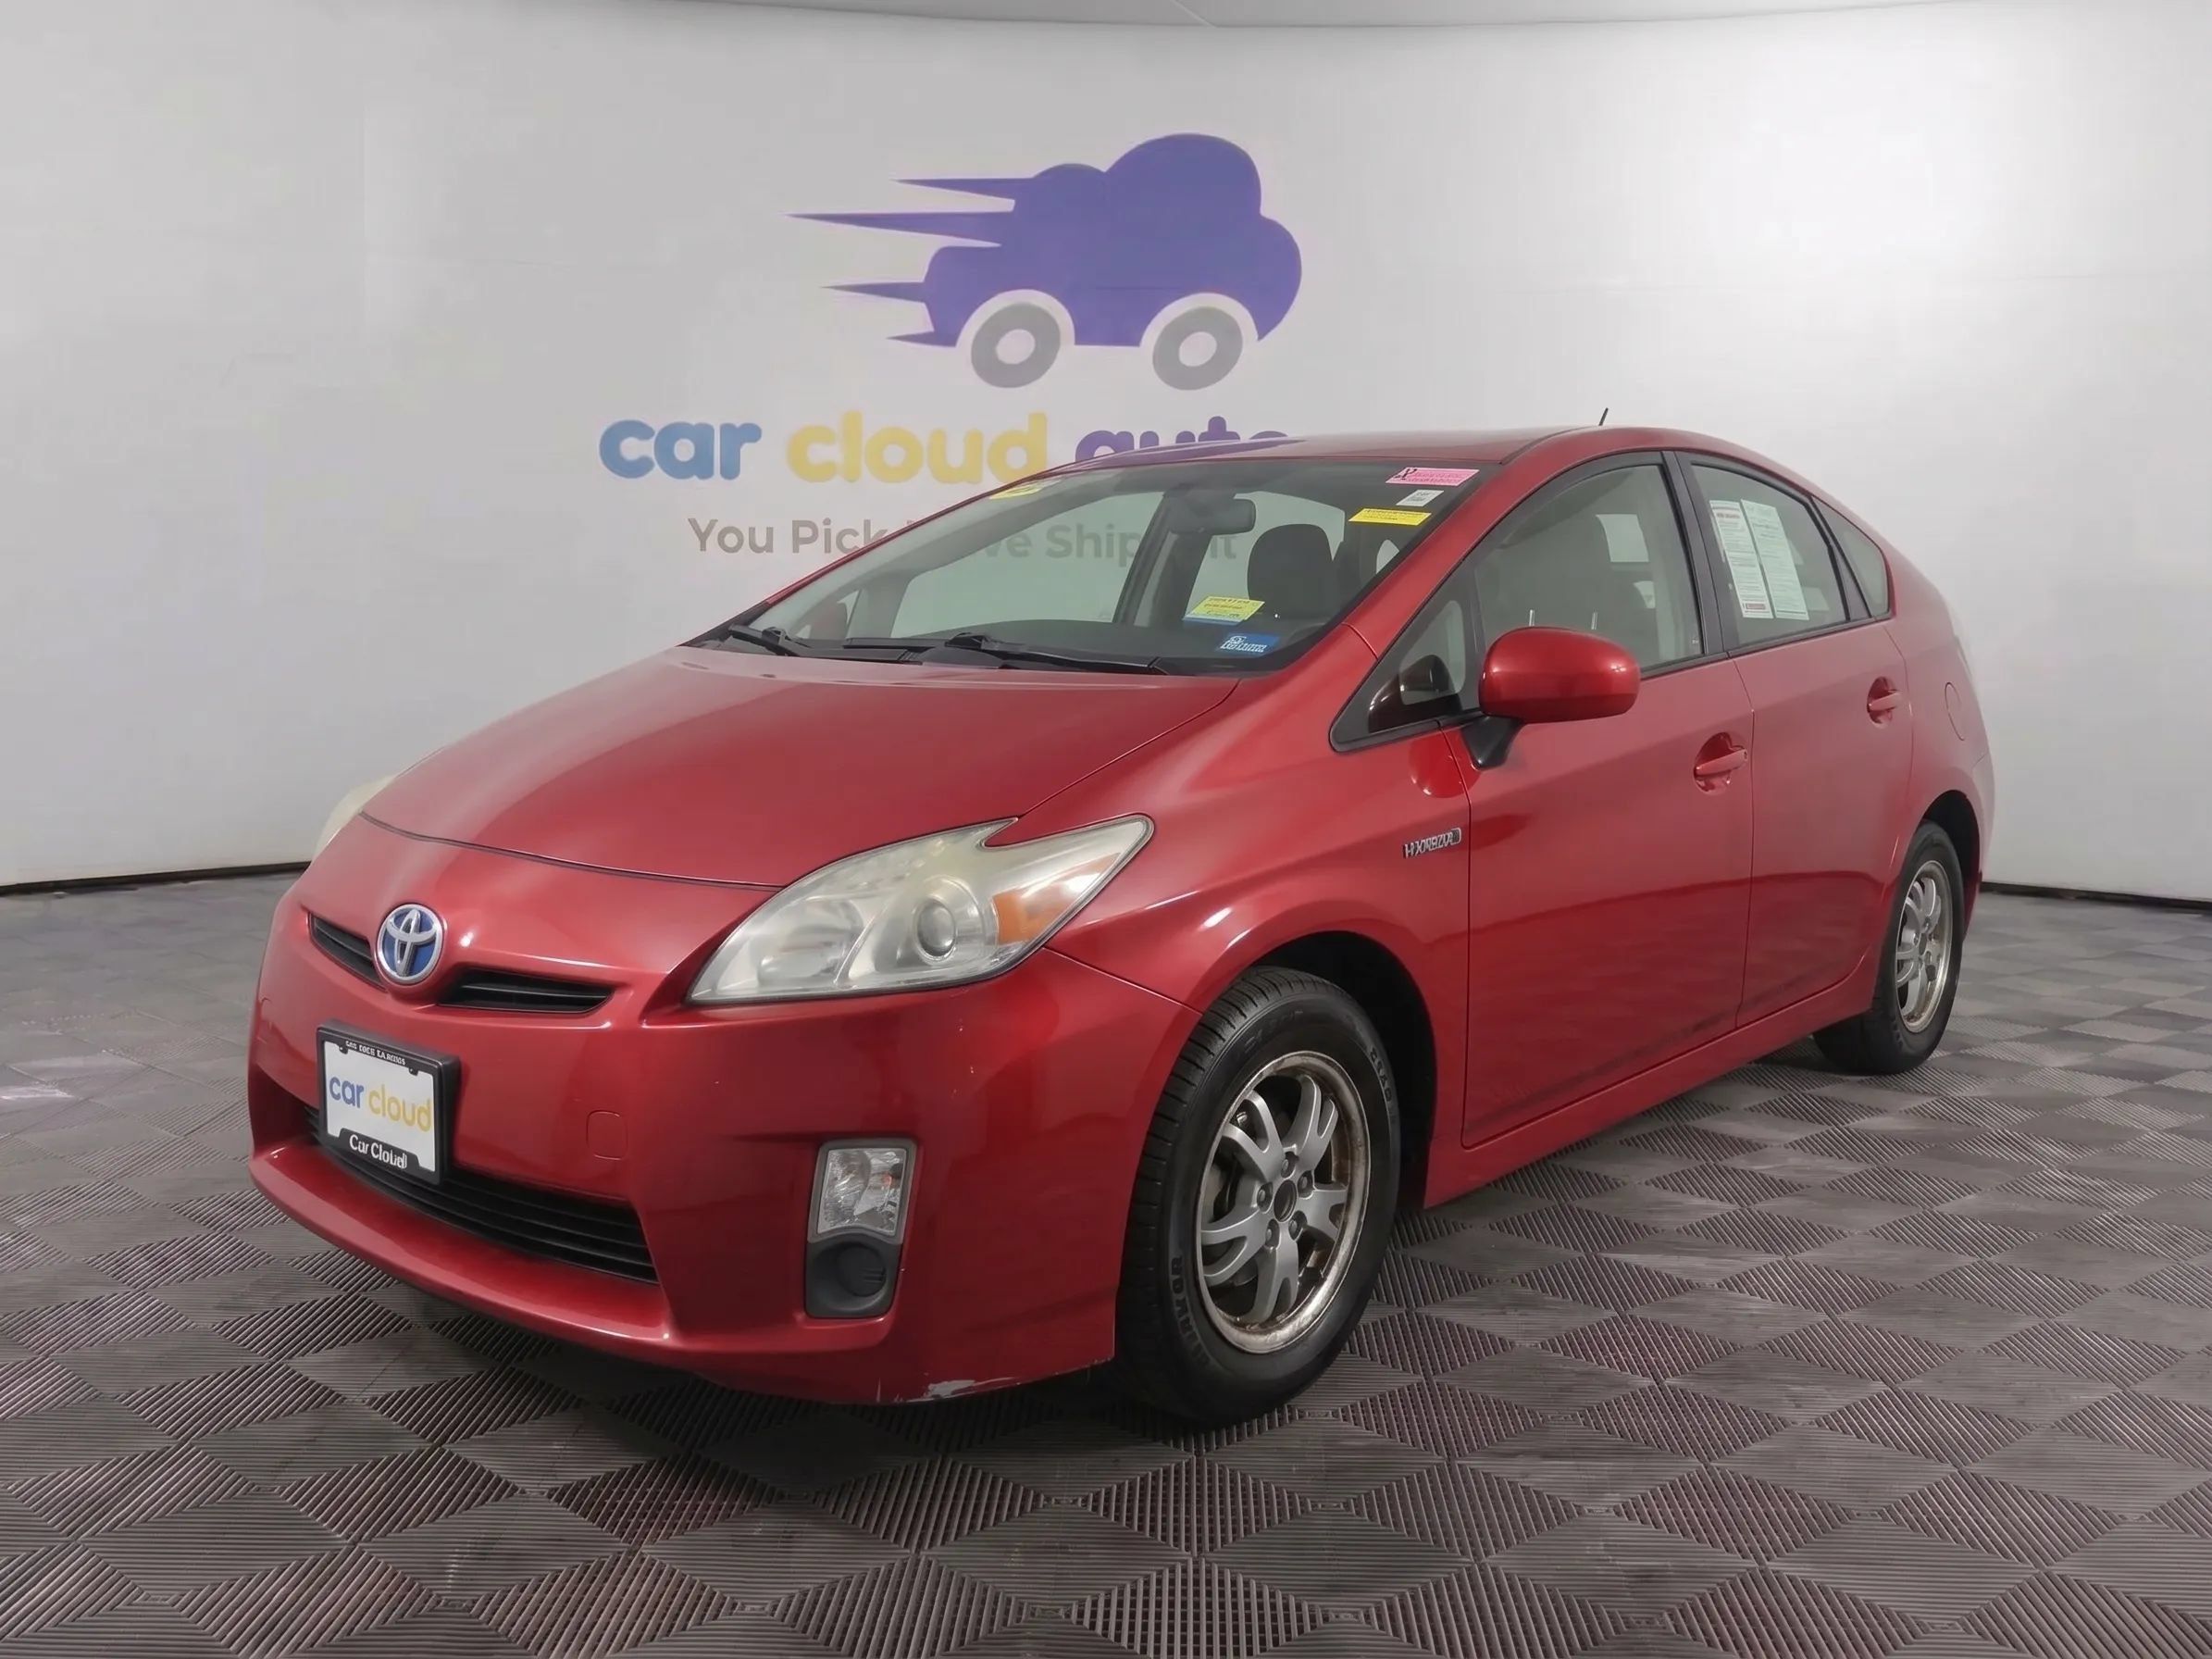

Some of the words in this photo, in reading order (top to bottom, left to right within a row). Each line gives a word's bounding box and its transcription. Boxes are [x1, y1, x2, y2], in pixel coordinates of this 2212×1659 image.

[599, 419, 763, 480] car
[786, 410, 1048, 484] cloud
[688, 518, 774, 554] You
[1045, 523, 1141, 567] Ship
[329, 1077, 364, 1108] car
[368, 1084, 431, 1132] cloud
[350, 1134, 369, 1154] Car
